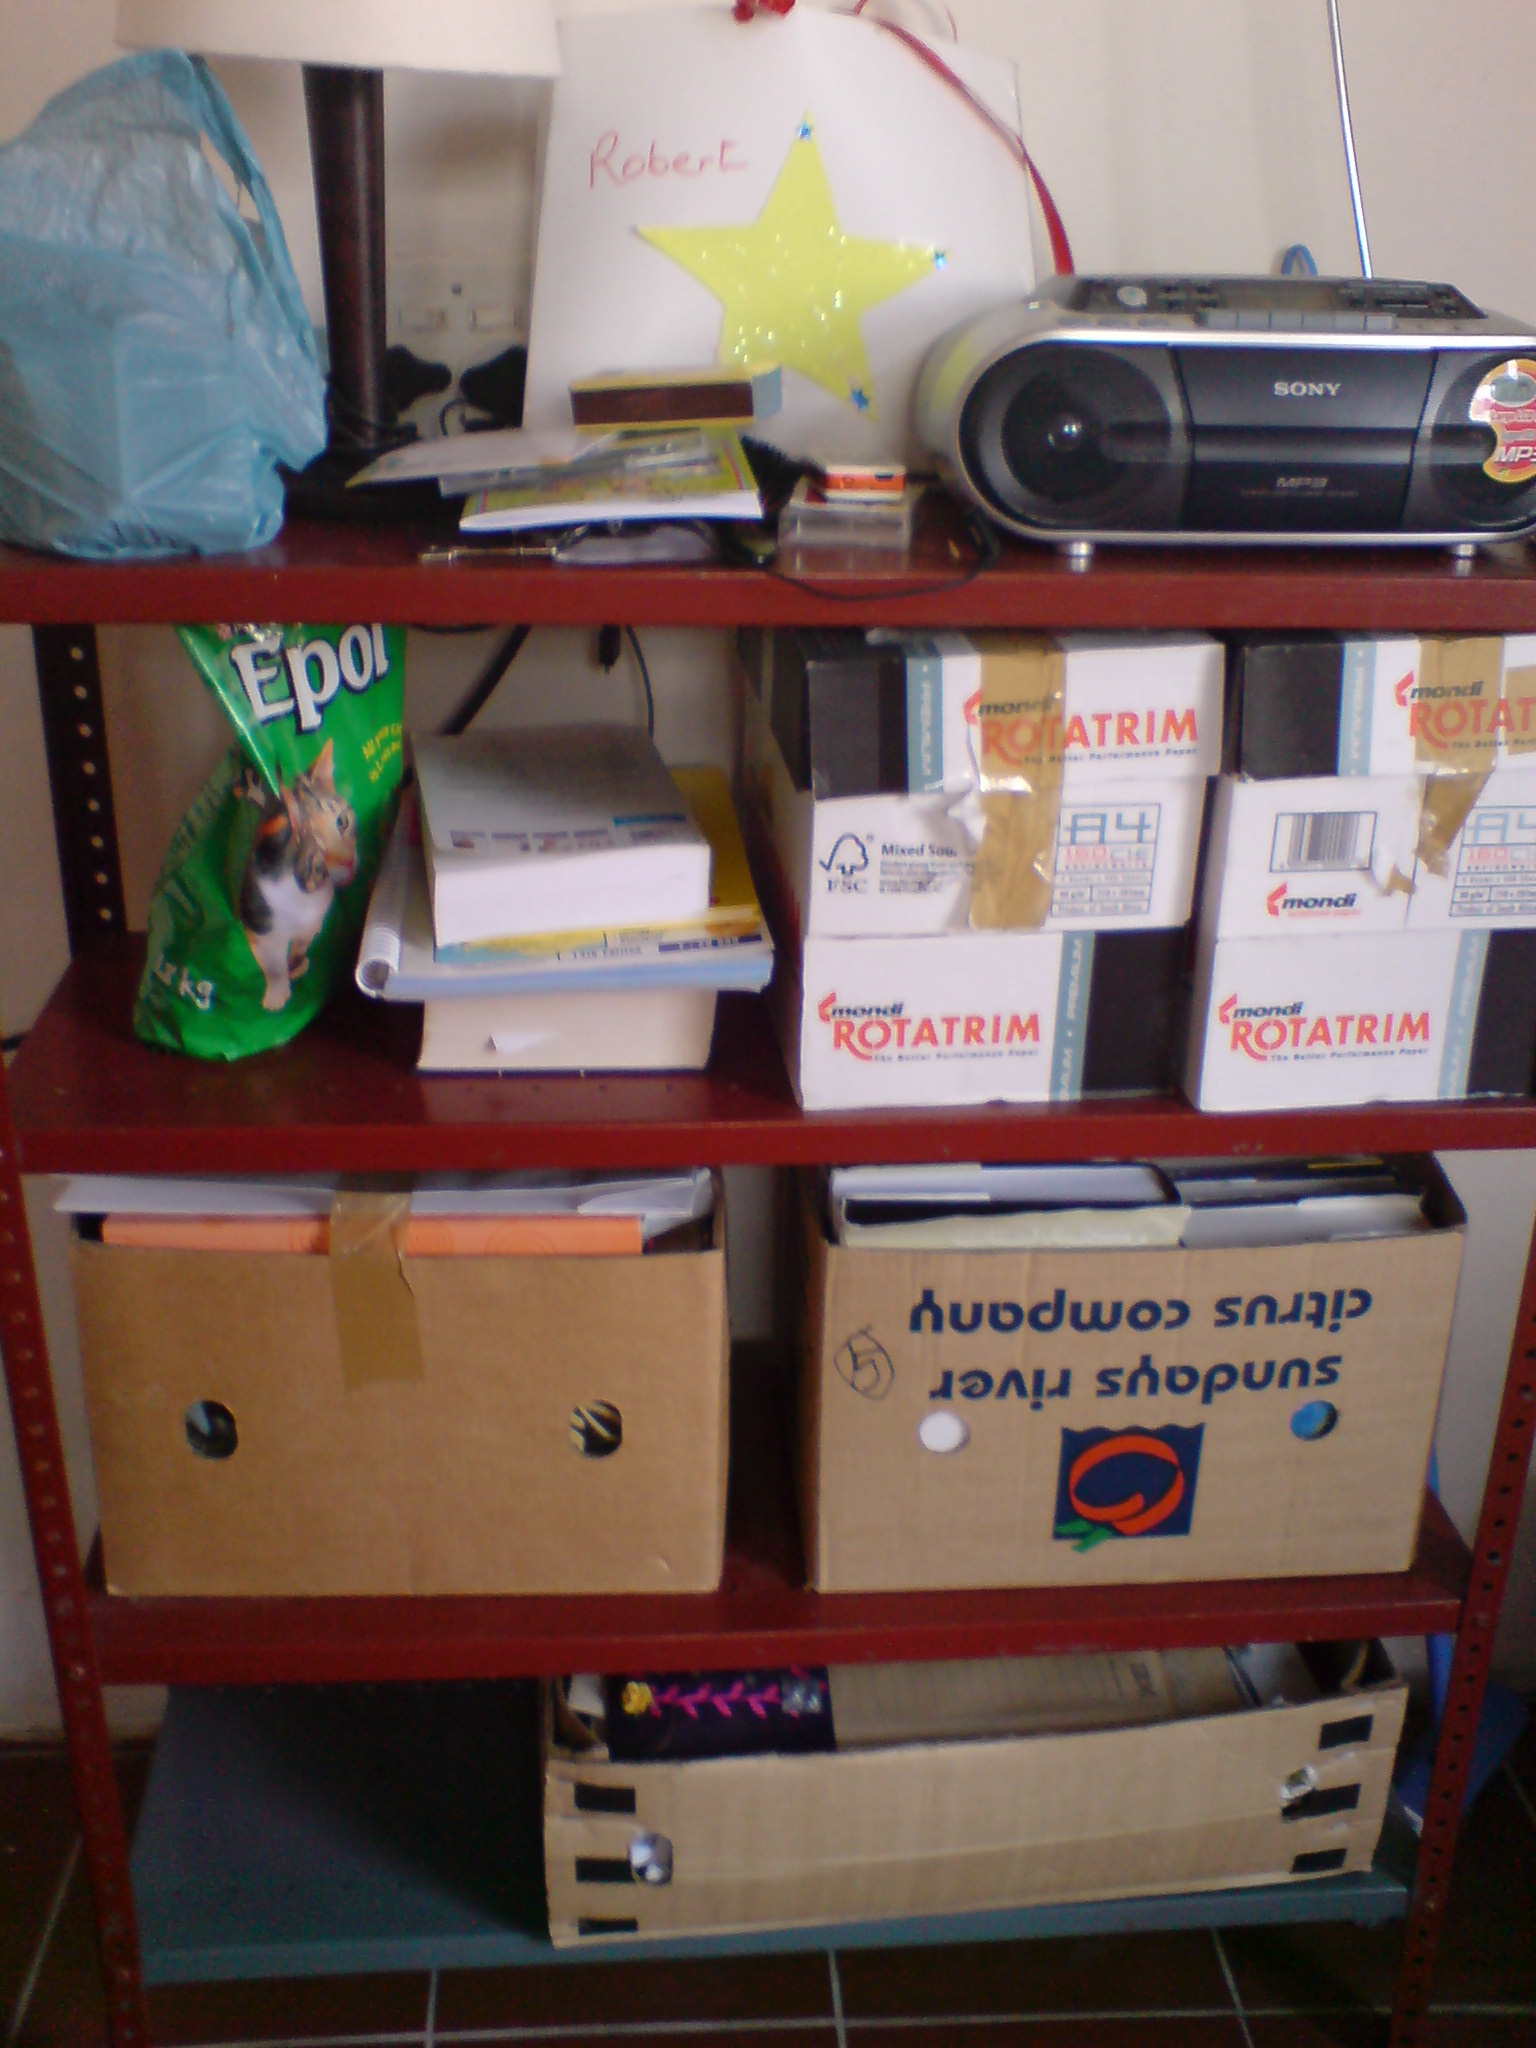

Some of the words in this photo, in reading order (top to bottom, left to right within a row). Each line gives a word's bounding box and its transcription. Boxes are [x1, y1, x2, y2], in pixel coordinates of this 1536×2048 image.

[588, 130, 748, 189] Robert
[1273, 381, 1341, 397] SONY
[230, 622, 389, 733] Epol
[1410, 681, 1484, 699] mondi
[982, 708, 1199, 767] ROTATRIM
[881, 842, 925, 857] Mixed
[1065, 811, 1152, 845] A4
[1281, 892, 1358, 910] mondi
[831, 1001, 904, 1018] mondi
[1233, 1001, 1304, 1019] mondi
[833, 1013, 1041, 1062] ROTATRIM
[1230, 1011, 1430, 1063] ROTATRIM
[909, 1288, 1191, 1334] company
[1213, 1288, 1373, 1333] citrus
[928, 1367, 1072, 1411] river
[1096, 1354, 1343, 1405] sundays
